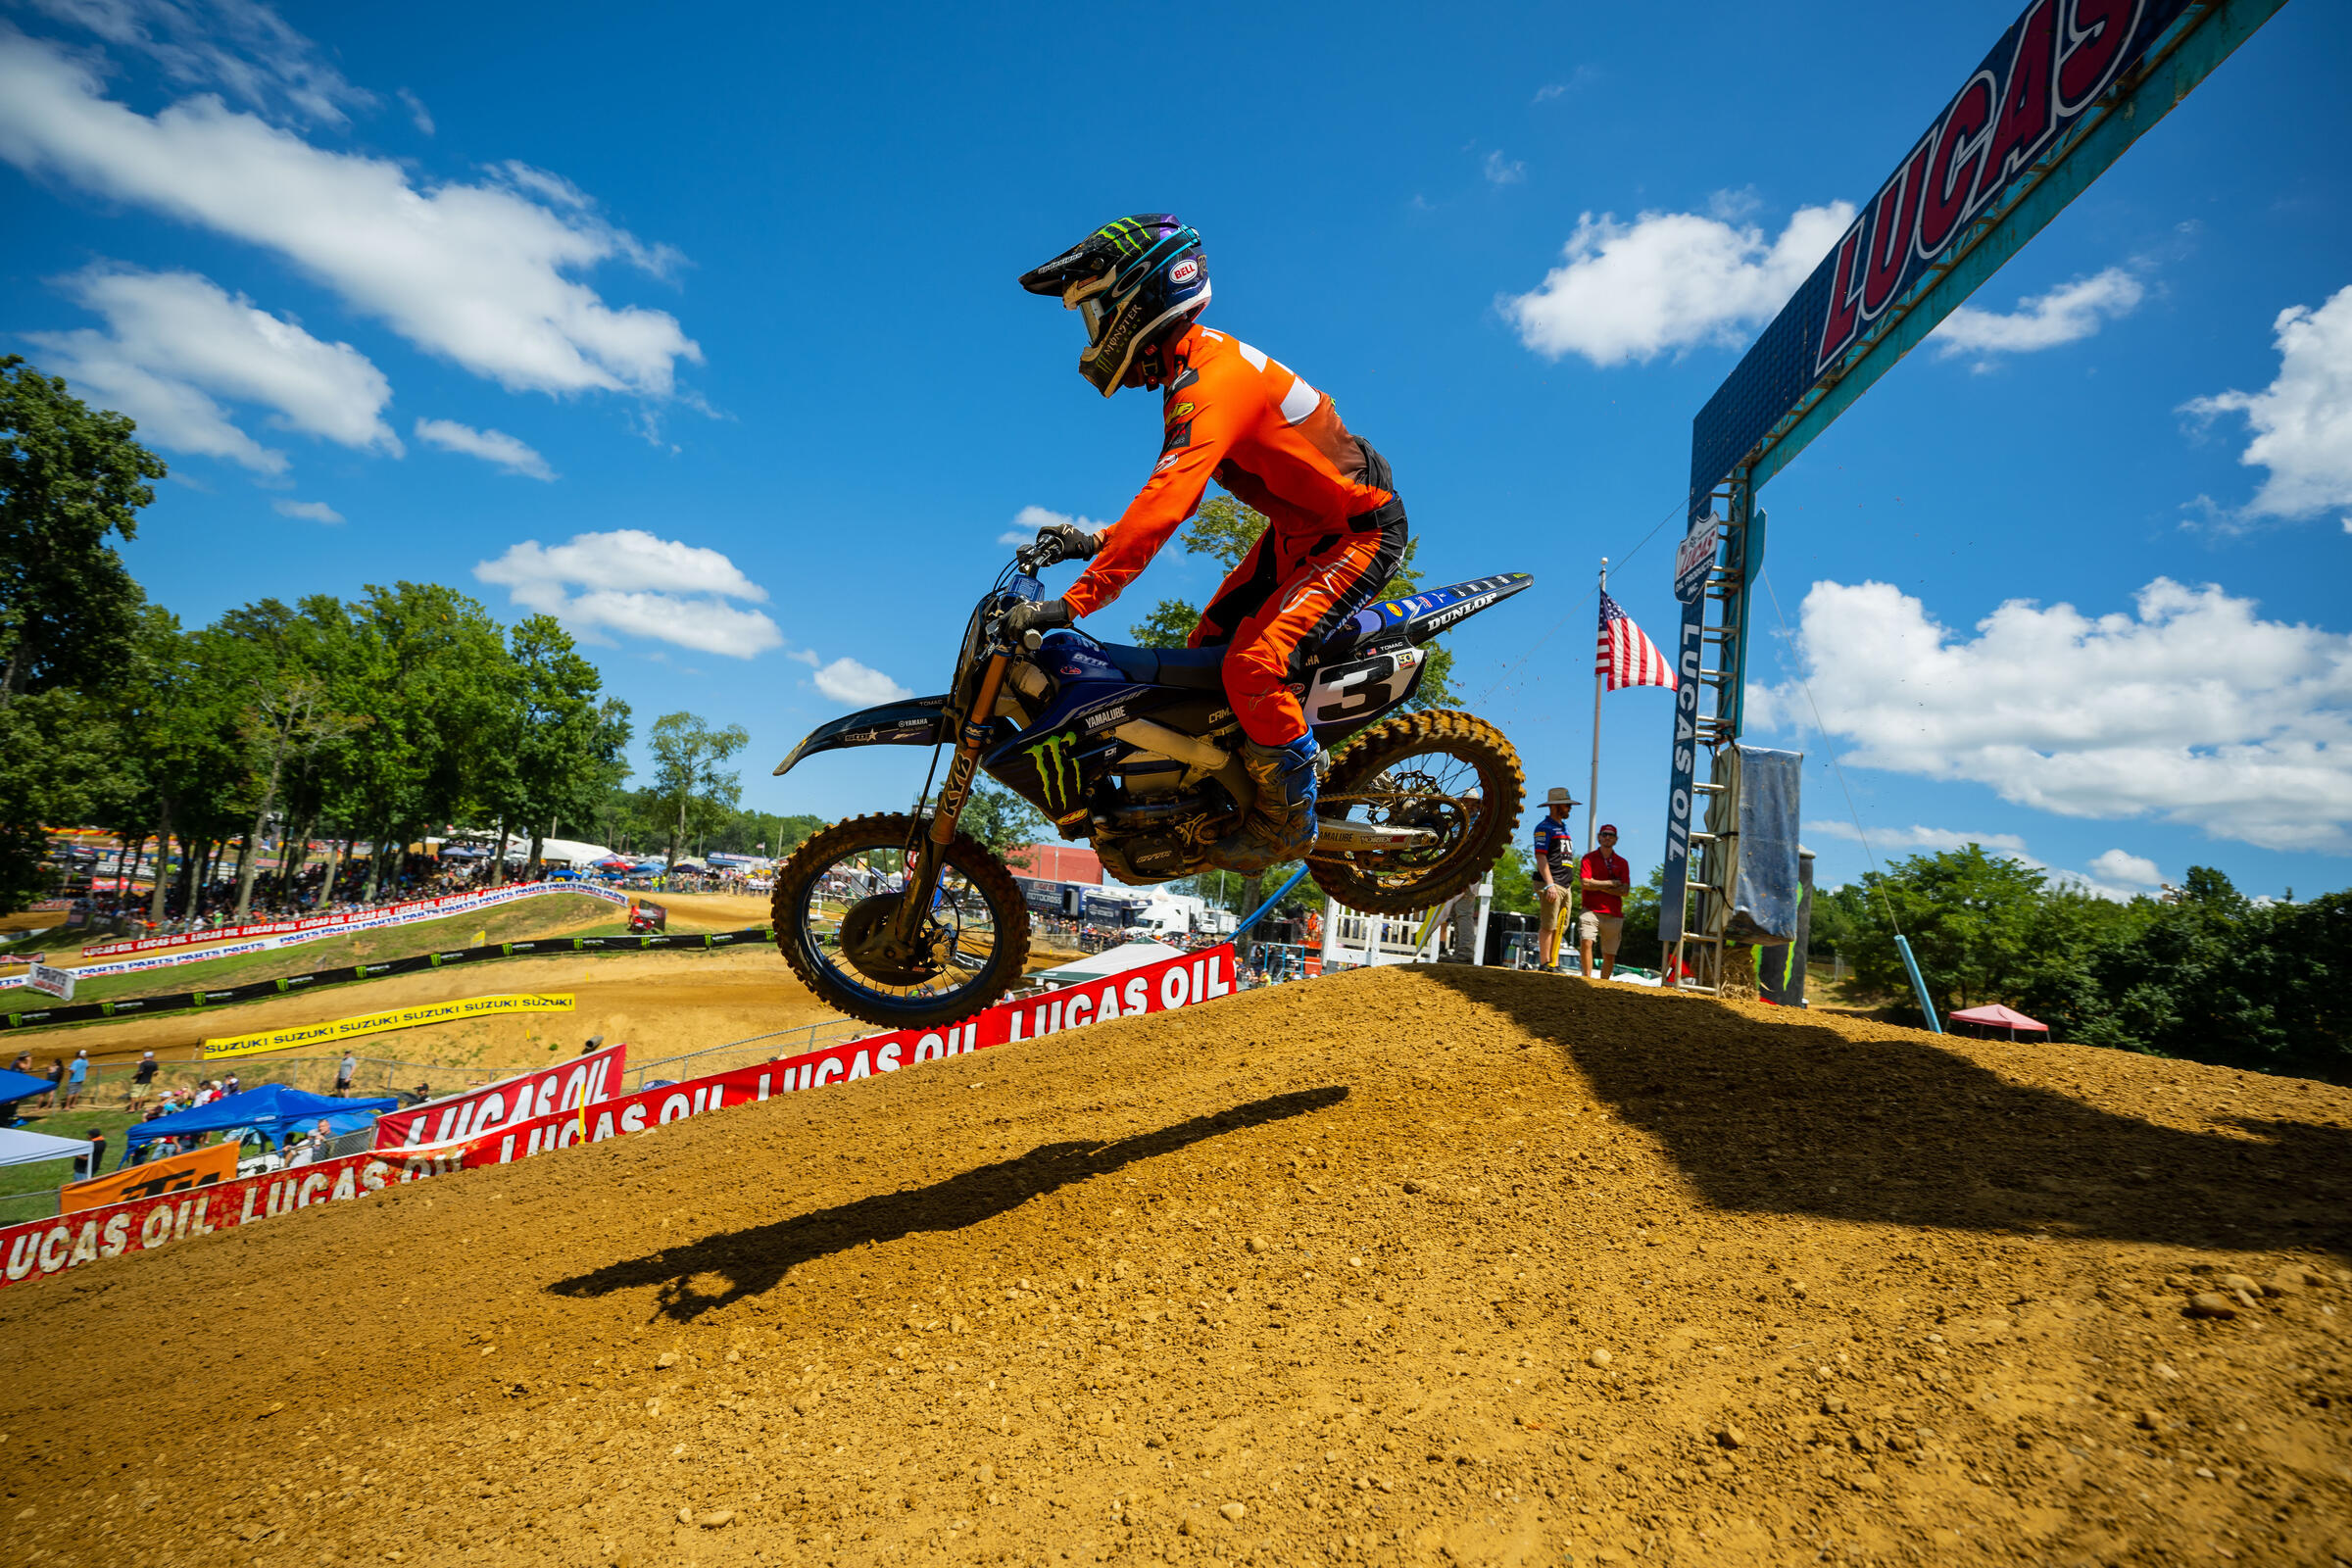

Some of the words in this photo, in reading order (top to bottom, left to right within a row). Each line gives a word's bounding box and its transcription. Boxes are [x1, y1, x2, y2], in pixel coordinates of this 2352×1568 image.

[1814, 0, 2146, 378] LUCAS
[1174, 264, 1196, 279] BELL
[1103, 304, 1143, 356] MONSTER
[1679, 530, 1716, 577] LUCAS
[1428, 593, 1497, 632] DUNLOP
[1380, 641, 1403, 652] TOMAC
[1398, 653, 1412, 663] 50
[1317, 656, 1395, 721] 3
[1675, 623, 1700, 775] LUCAS
[905, 718, 928, 727] YAMAHA
[1085, 706, 1127, 729] YAMALUBE
[943, 752, 972, 818] KYB
[1318, 832, 1353, 843] AMALUBE
[1668, 788, 1689, 862] OIL
[206, 1038, 268, 1054] SUZUKI
[273, 1027, 334, 1044] SUZUKI
[340, 1015, 398, 1032] SUZUKI
[403, 1006, 460, 1021] SUZUKI
[465, 1000, 516, 1011] SUZUKI
[141, 1197, 215, 1250] OIL
[239, 1160, 389, 1225] LUCAS
[1009, 976, 1149, 1043] LUCAS
[1160, 956, 1230, 1010] OIL
